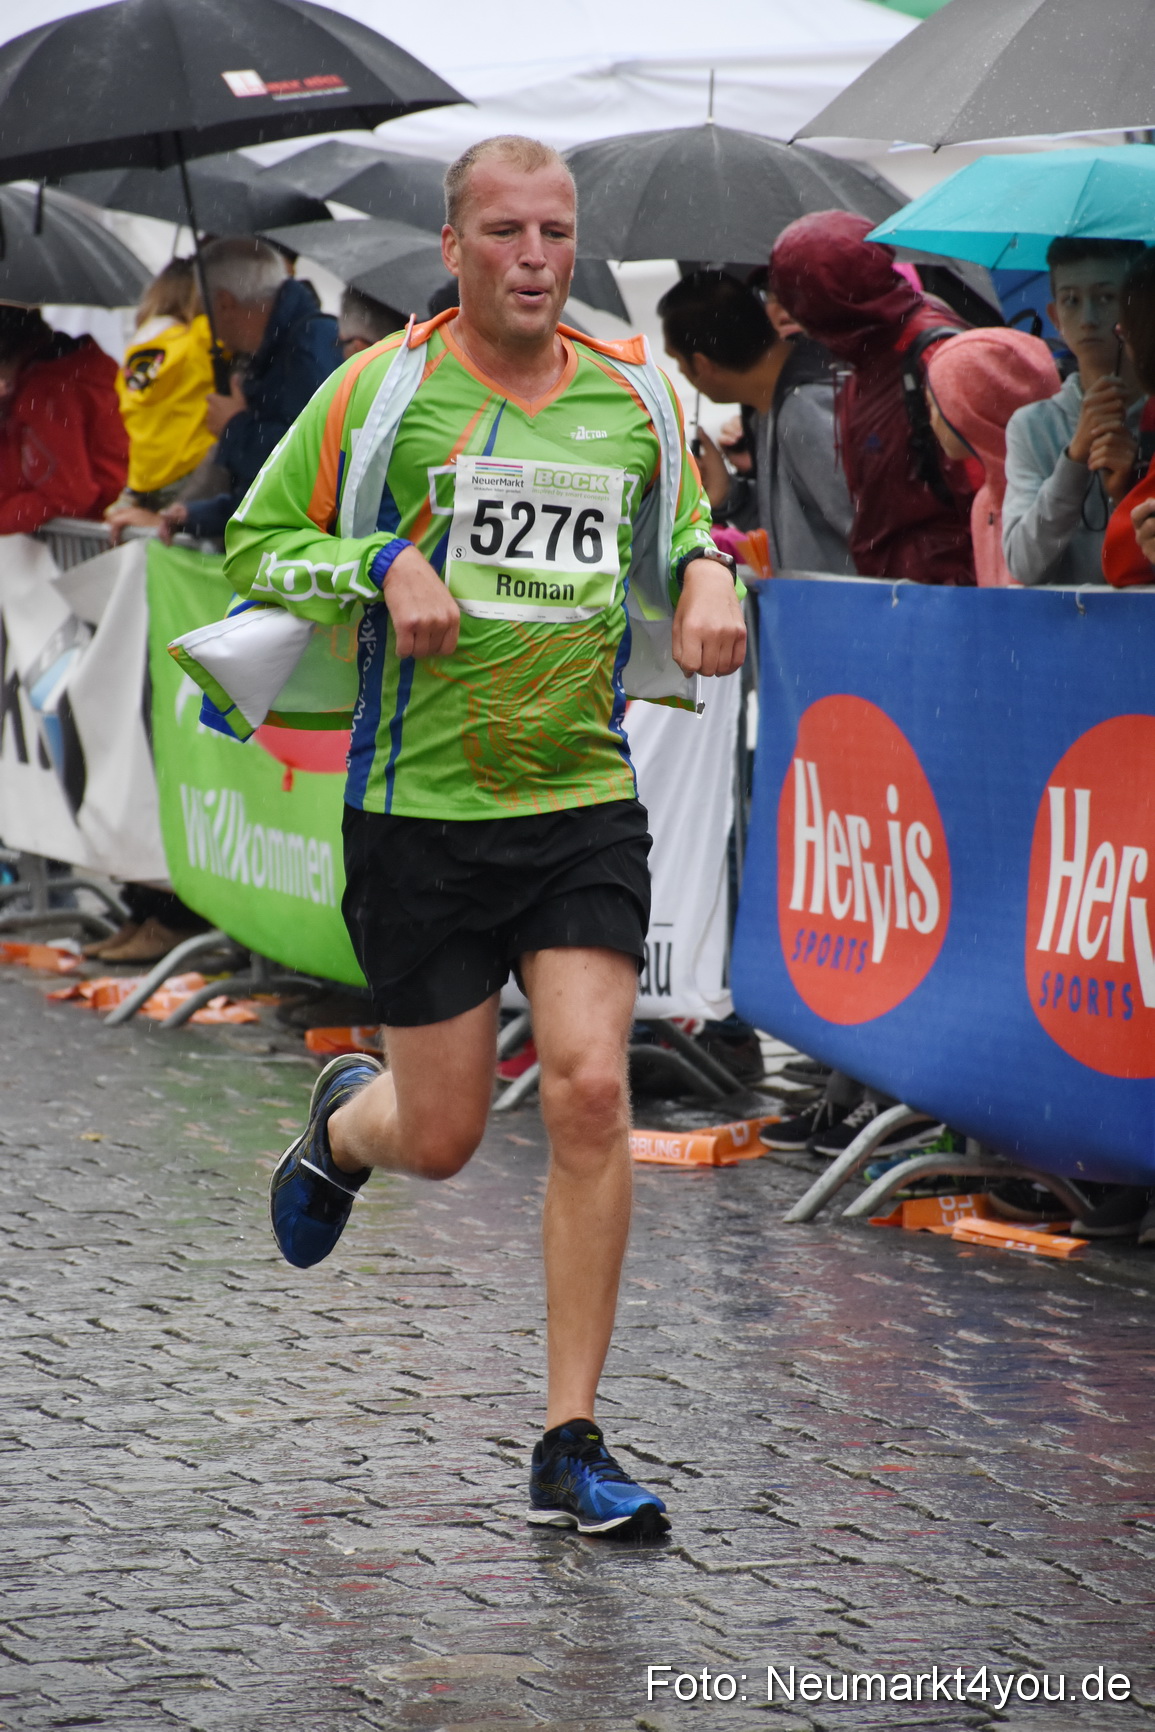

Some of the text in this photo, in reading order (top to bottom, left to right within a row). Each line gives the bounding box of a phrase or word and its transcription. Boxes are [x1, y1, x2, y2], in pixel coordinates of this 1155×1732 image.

[472, 476, 524, 488] NeuerMarkt
[532, 488, 555, 497] inspired
[556, 490, 565, 498] by
[583, 493, 610, 502] concepts
[533, 468, 610, 494] BOCK
[470, 499, 604, 564] 5276
[496, 573, 574, 601] Roman
[180, 783, 337, 908] Willkommen
[789, 758, 940, 964] Hervis
[791, 928, 868, 975] SPORTS
[1039, 970, 1133, 1021] SPORTS
[628, 1136, 682, 1159] RBUNG
